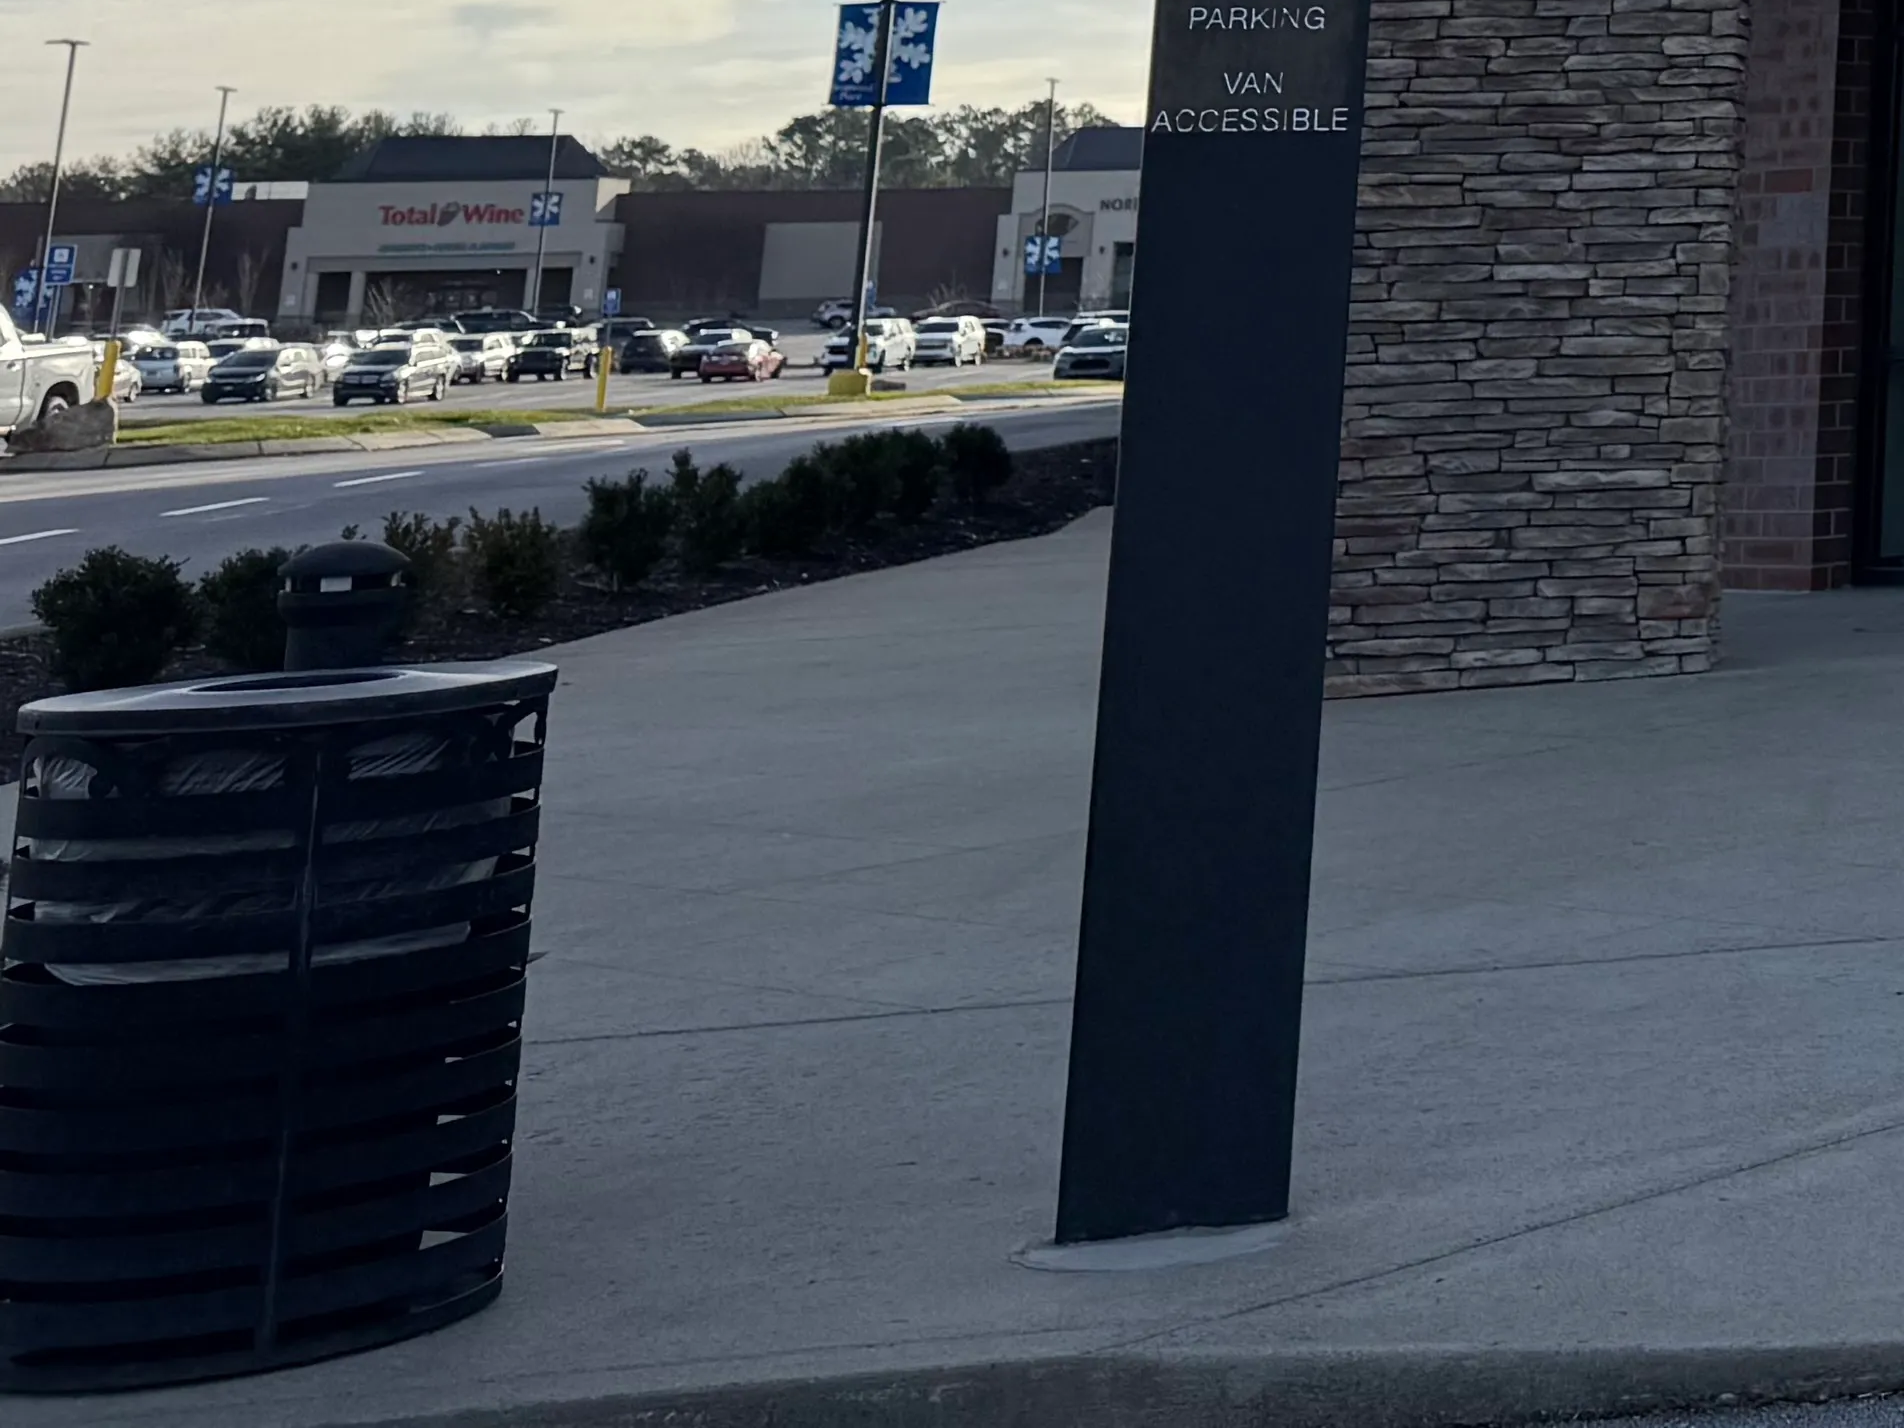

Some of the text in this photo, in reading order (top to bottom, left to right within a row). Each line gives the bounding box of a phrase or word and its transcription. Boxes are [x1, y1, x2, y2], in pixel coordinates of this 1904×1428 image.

[1189, 6, 1327, 31] PARKING
[1223, 71, 1284, 95] VAN
[1151, 107, 1350, 133] ACCESSIBLE
[378, 202, 525, 226] Total Wine
